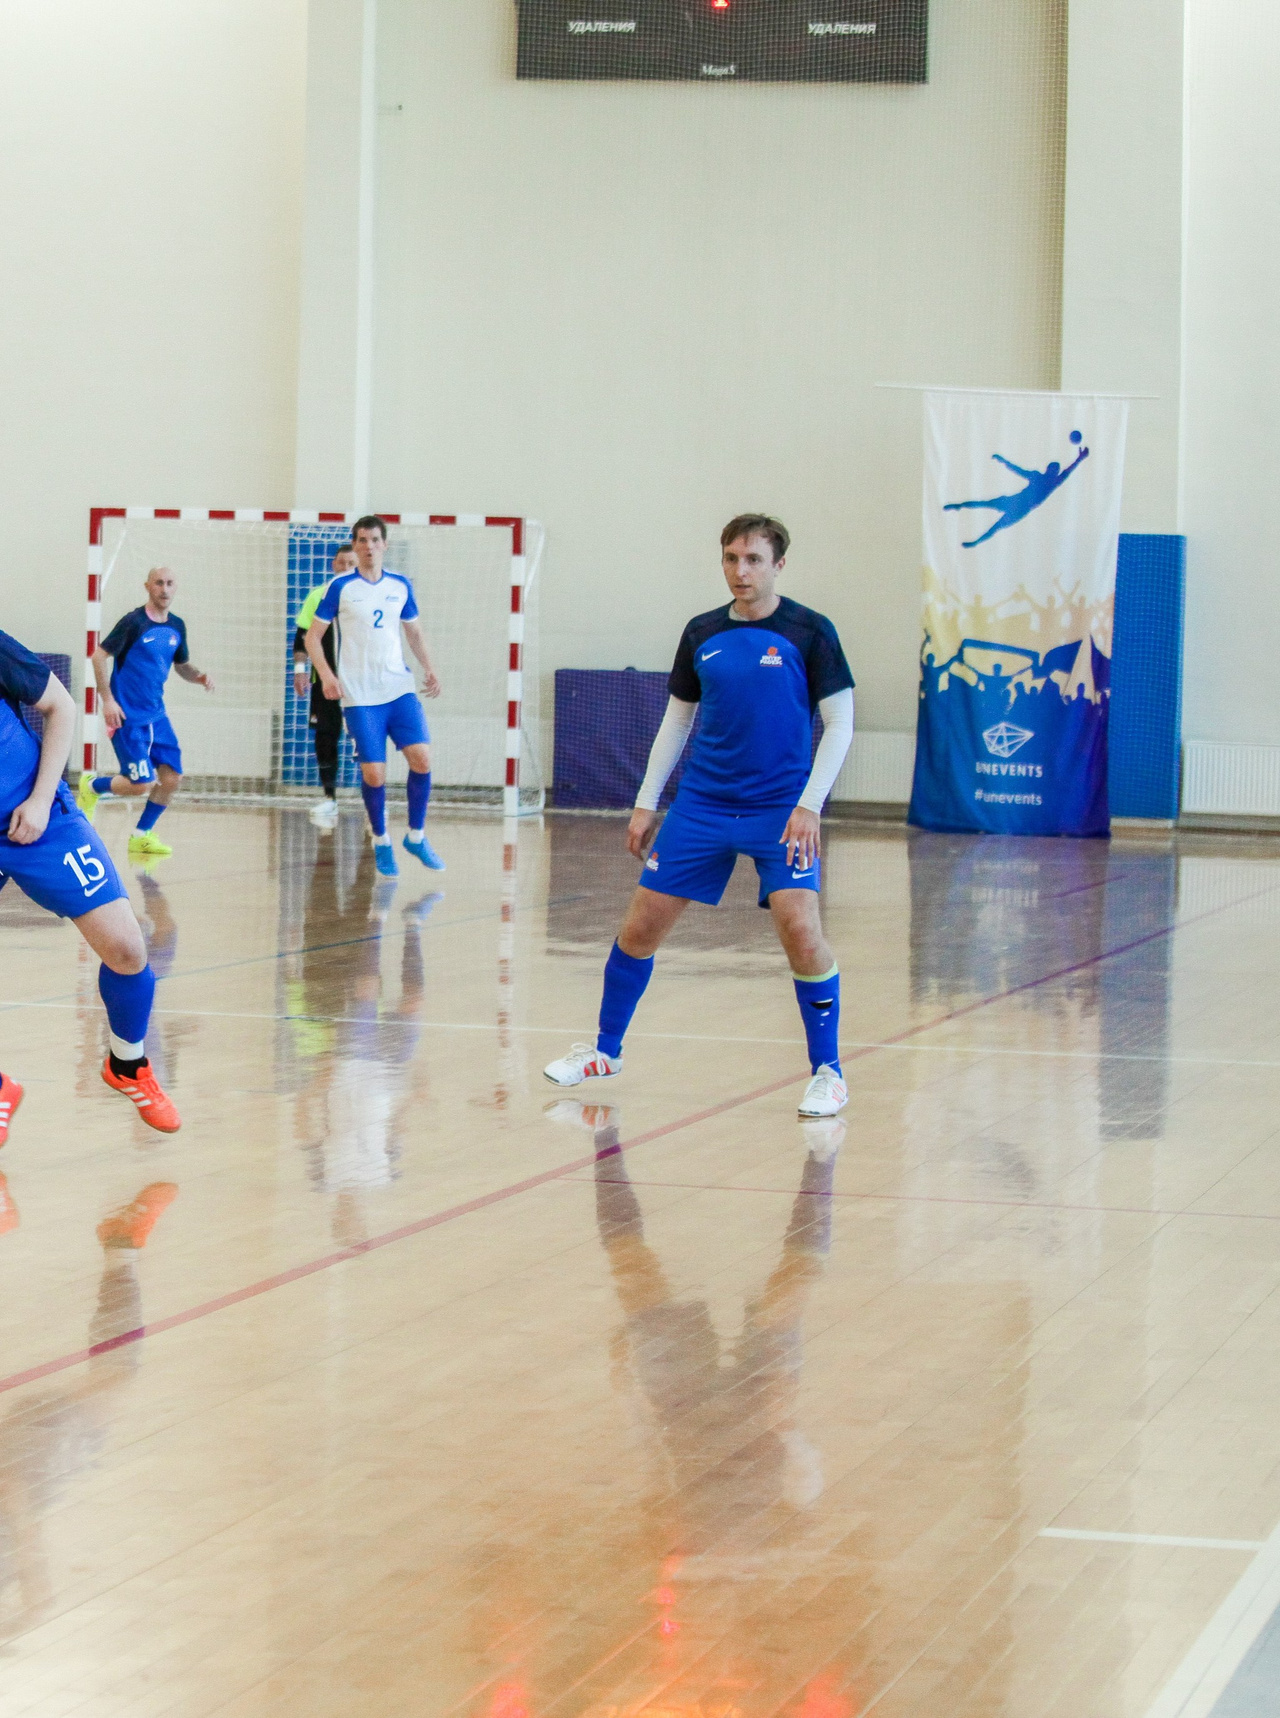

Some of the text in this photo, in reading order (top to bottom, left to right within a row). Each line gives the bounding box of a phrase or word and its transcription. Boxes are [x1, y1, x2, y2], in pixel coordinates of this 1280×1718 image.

[568, 21, 636, 34] УДАЛЕНИЯ
[807, 22, 876, 35] УДАЛЕНИЯ
[373, 609, 384, 629] 2
[128, 760, 151, 781] 34
[975, 762, 1043, 778] UNEVENTS
[974, 788, 1043, 806] #unevents
[63, 844, 106, 887] 15
